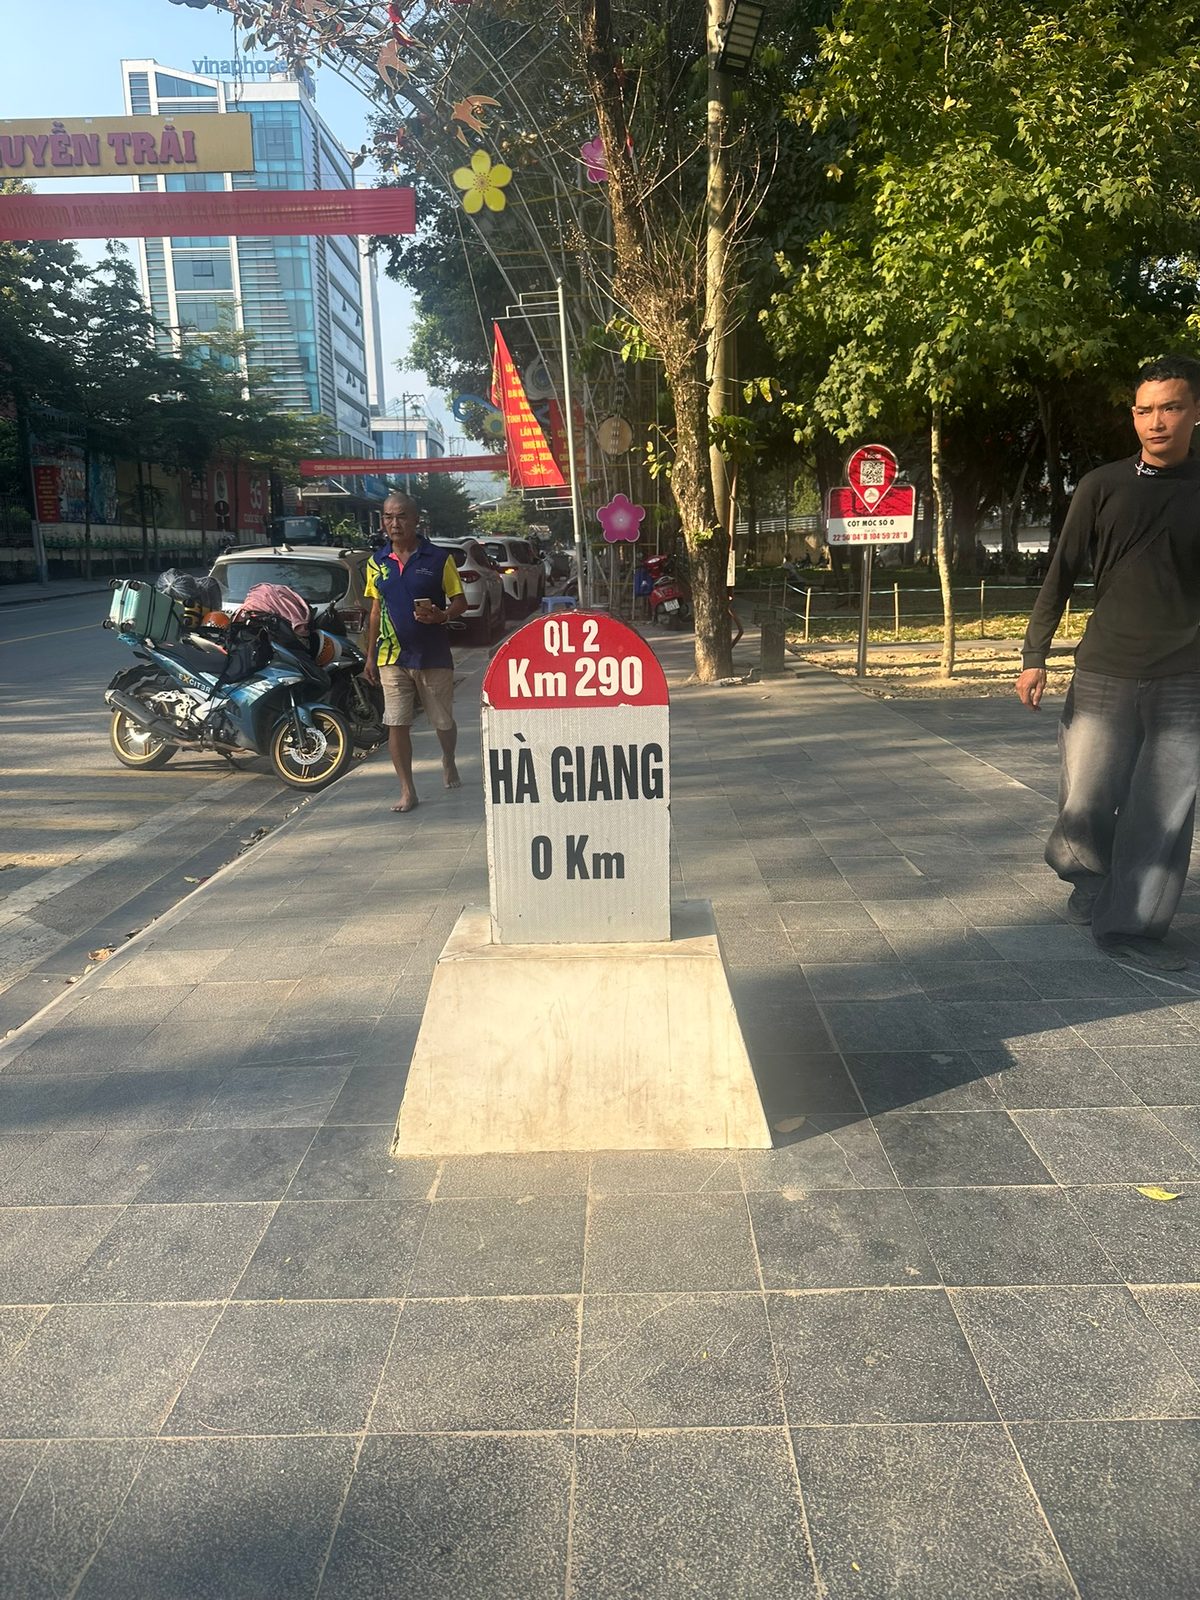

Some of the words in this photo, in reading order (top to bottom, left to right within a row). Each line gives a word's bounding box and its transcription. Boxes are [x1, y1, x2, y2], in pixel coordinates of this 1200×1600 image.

[0, 121, 100, 168] UYỄN
[107, 125, 197, 165] TRÃI
[543, 620, 576, 656] QL
[582, 619, 600, 652] 2
[508, 658, 567, 697] Km
[575, 656, 643, 696] 290
[489, 732, 540, 804] HÀ
[551, 742, 664, 802] GIANG
[531, 835, 553, 880] 0
[566, 834, 625, 879] Km
